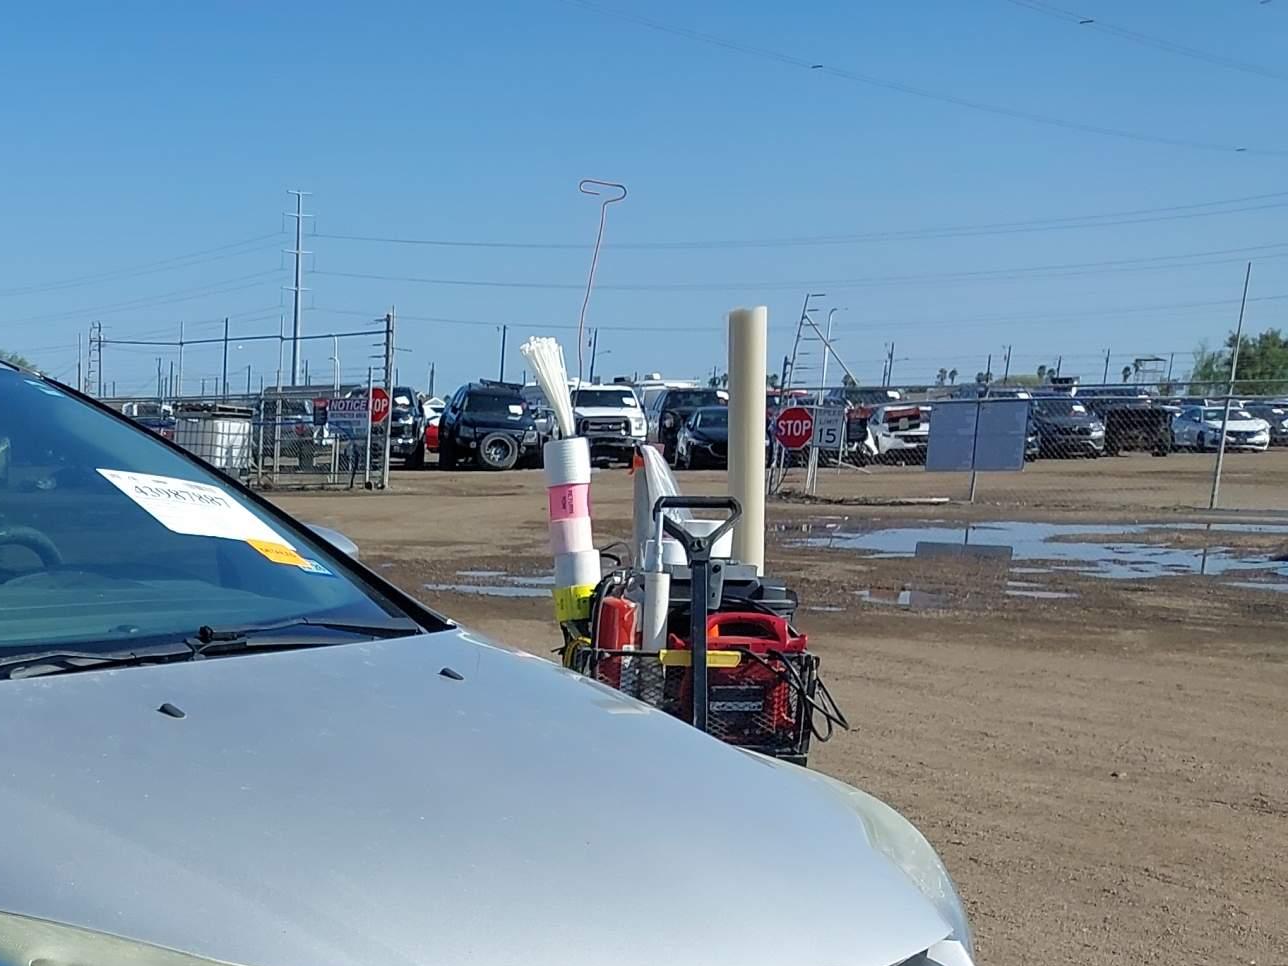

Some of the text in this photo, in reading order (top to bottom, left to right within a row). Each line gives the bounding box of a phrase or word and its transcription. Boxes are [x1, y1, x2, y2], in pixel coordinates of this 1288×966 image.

[331, 400, 367, 410] NOTICE
[778, 419, 811, 437] STOP
[818, 428, 837, 444] 15
[134, 485, 231, 509] 43987887
